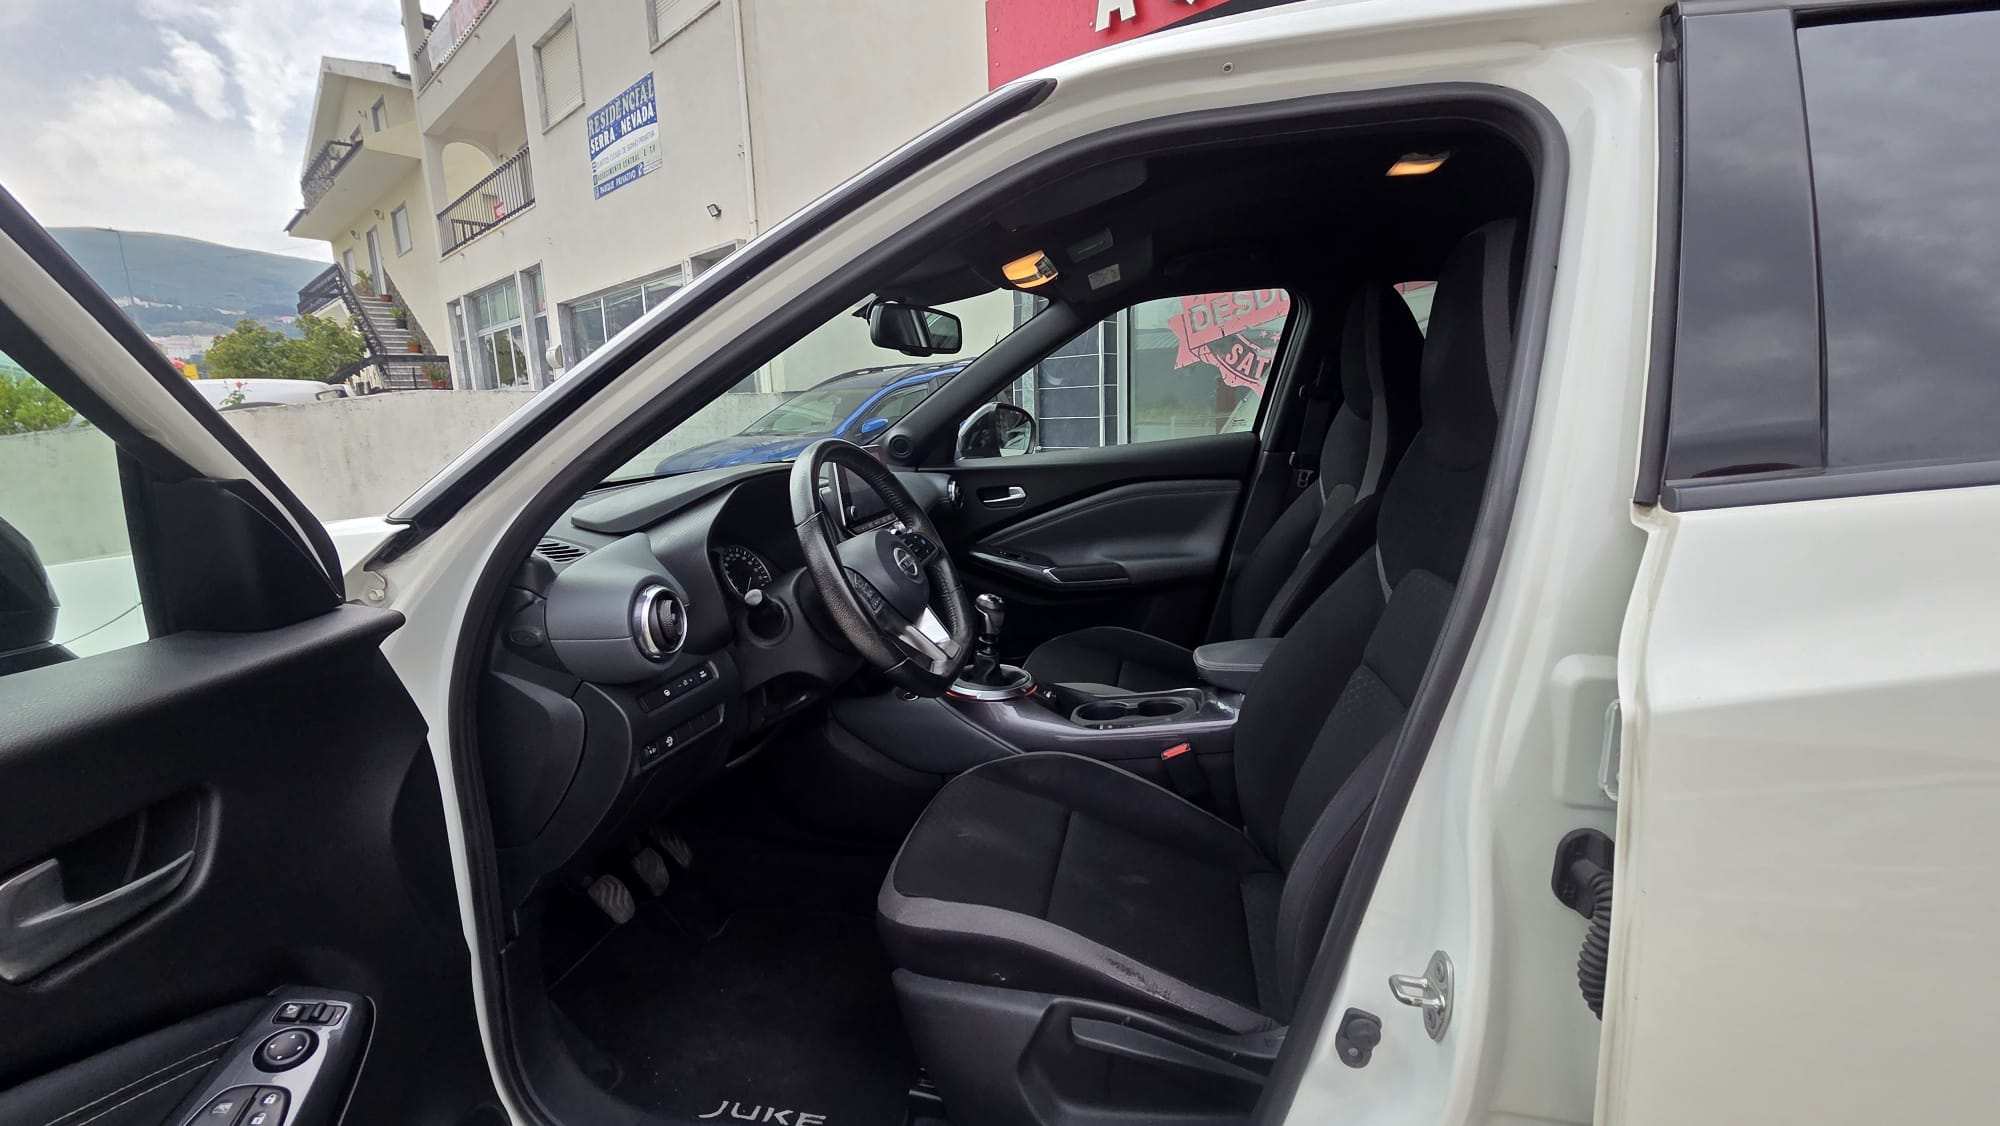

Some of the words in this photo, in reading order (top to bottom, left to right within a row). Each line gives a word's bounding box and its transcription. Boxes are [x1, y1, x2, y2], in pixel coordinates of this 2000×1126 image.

[590, 127, 616, 154] SERRA
[620, 102, 655, 136] NEVADA
[698, 1100, 827, 1126] JUKE
